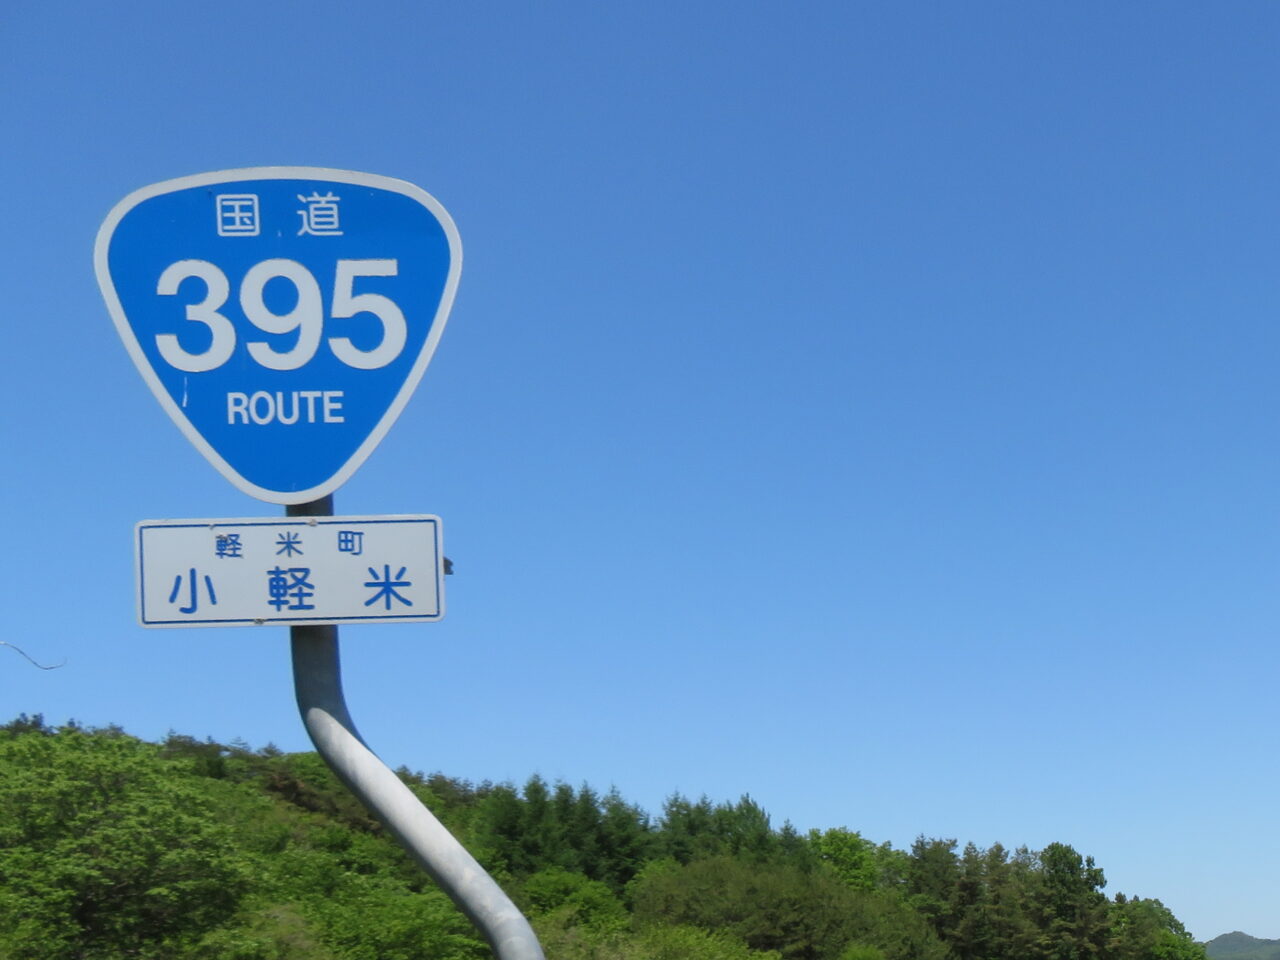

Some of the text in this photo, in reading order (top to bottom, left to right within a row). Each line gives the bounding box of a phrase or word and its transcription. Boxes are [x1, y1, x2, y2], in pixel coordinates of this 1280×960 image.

[216, 191, 344, 237] 国道
[154, 258, 408, 373] 395
[226, 391, 345, 425] ROUTE
[215, 531, 365, 559] 軽米町
[168, 564, 413, 615] 小軽米
